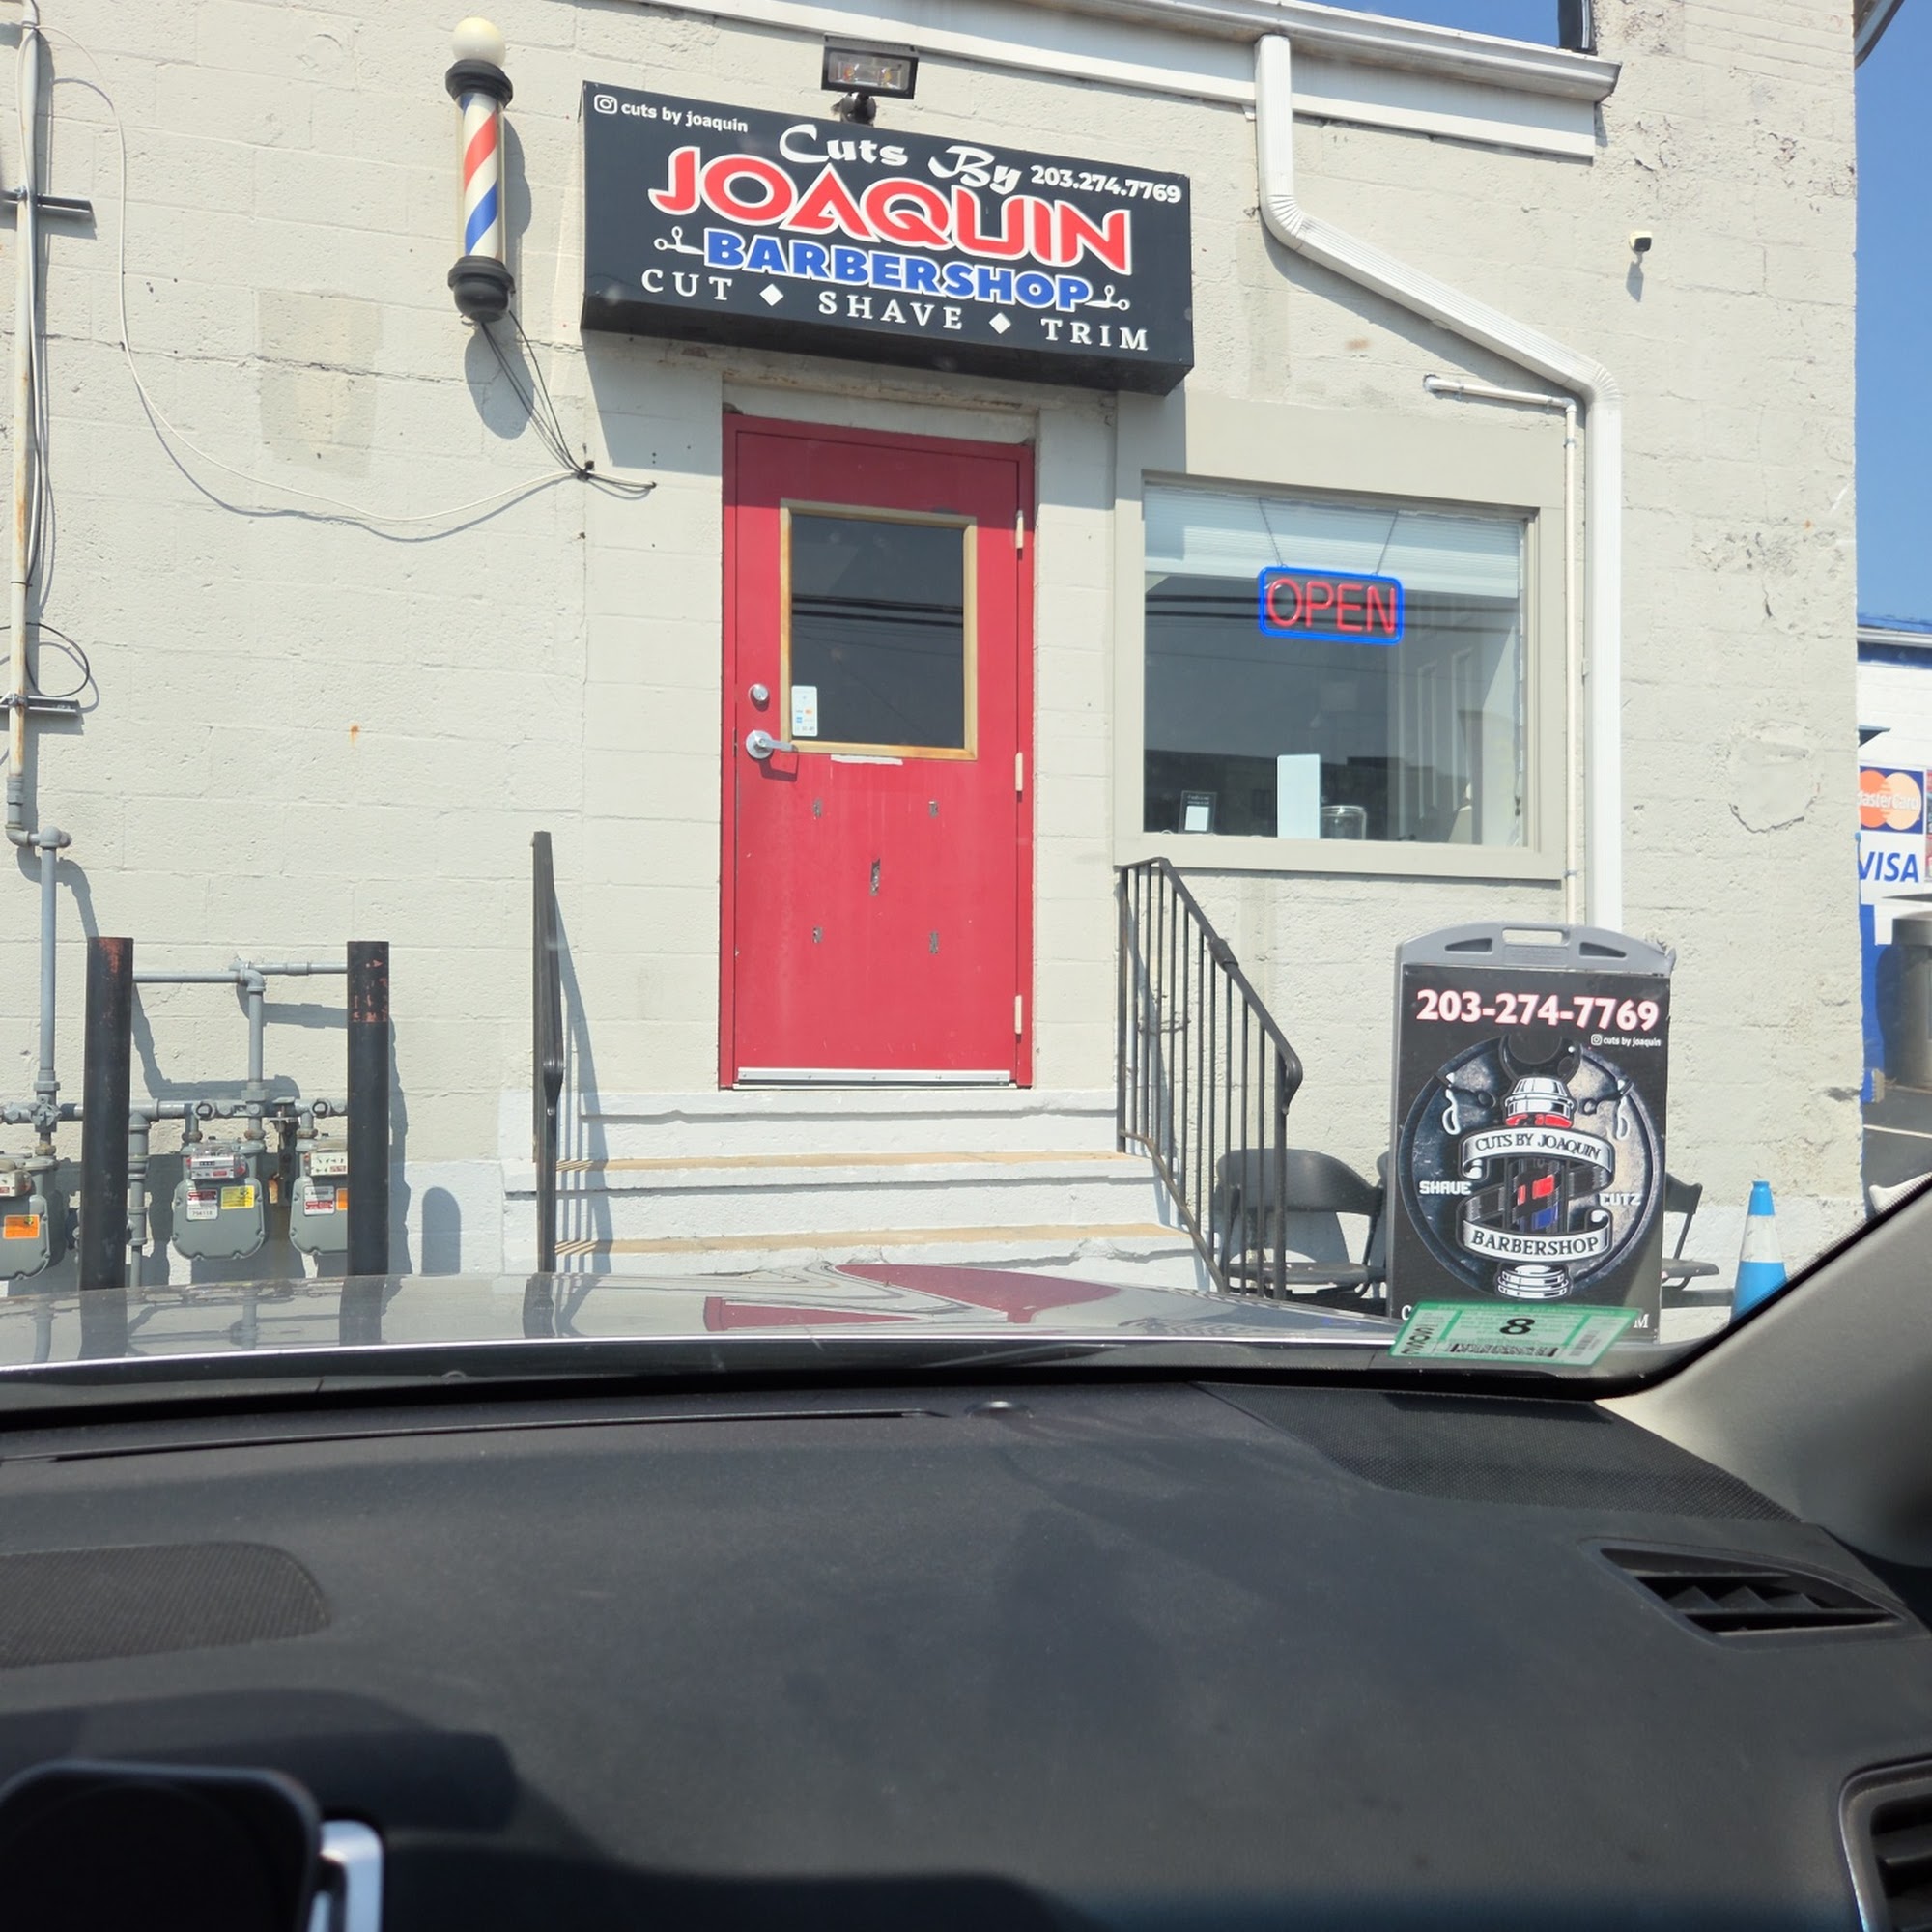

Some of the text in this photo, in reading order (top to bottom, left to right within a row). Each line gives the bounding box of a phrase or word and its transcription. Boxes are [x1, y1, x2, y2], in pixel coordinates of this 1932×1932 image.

[621, 102, 749, 133] cuts by joaquin
[779, 124, 1023, 195] Cuts By
[1030, 163, 1182, 204] 203.274.7769
[647, 145, 1132, 276] JOAQUIN
[703, 227, 1094, 313] BARBERSHOP
[641, 268, 1149, 353] CUT SHAVE TRIM
[1267, 578, 1396, 634] OPEN
[1859, 850, 1920, 884] VISA
[1416, 988, 1660, 1032] 203-274-7769
[1603, 1036, 1662, 1048] cuts by joaquin
[1475, 1133, 1602, 1161] CUTS BY JOAQUIN
[1599, 1192, 1642, 1207] CUTZ
[1471, 1230, 1599, 1256] BARBERSHOP
[1498, 1317, 1536, 1335] 8
